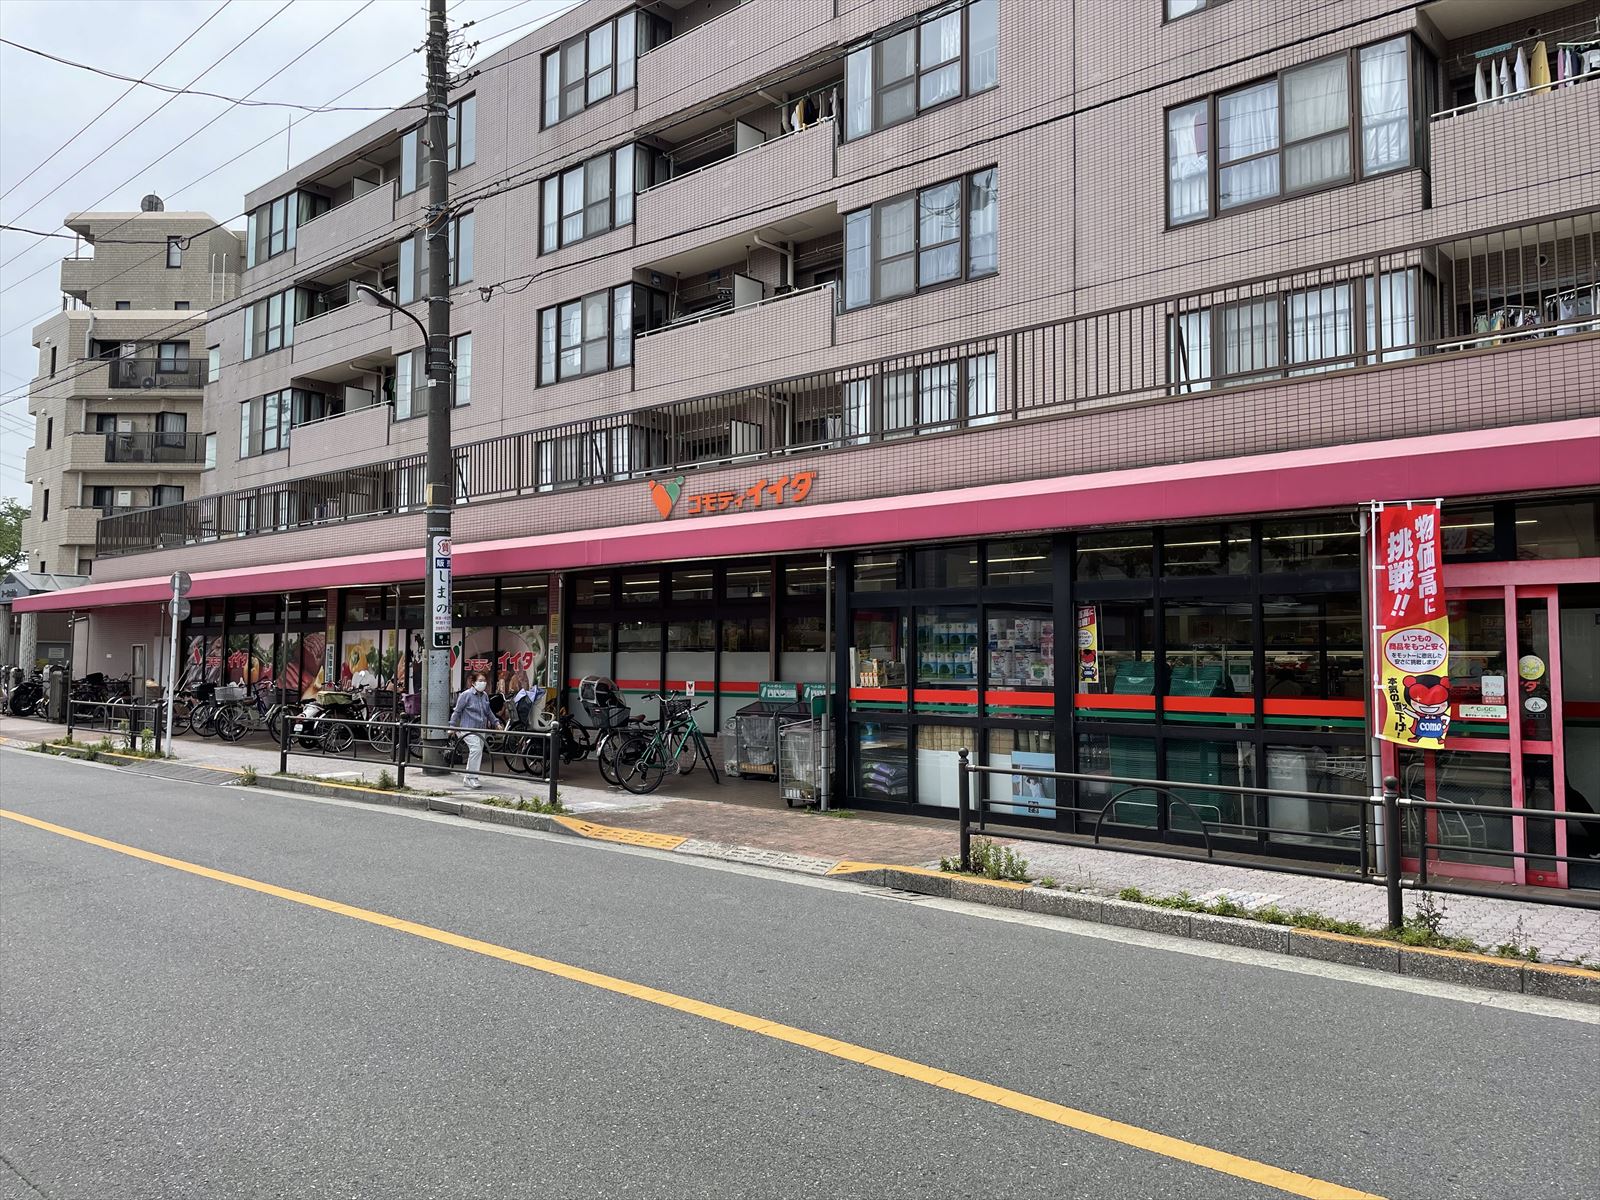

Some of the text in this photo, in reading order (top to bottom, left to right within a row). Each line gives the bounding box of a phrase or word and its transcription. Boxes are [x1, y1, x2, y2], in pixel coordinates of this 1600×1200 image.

[687, 471, 817, 514] コモディイイダ
[1415, 513, 1437, 614] 物価高に
[437, 570, 448, 613] しまの
[1388, 642, 1445, 651] 商品をもっと安く
